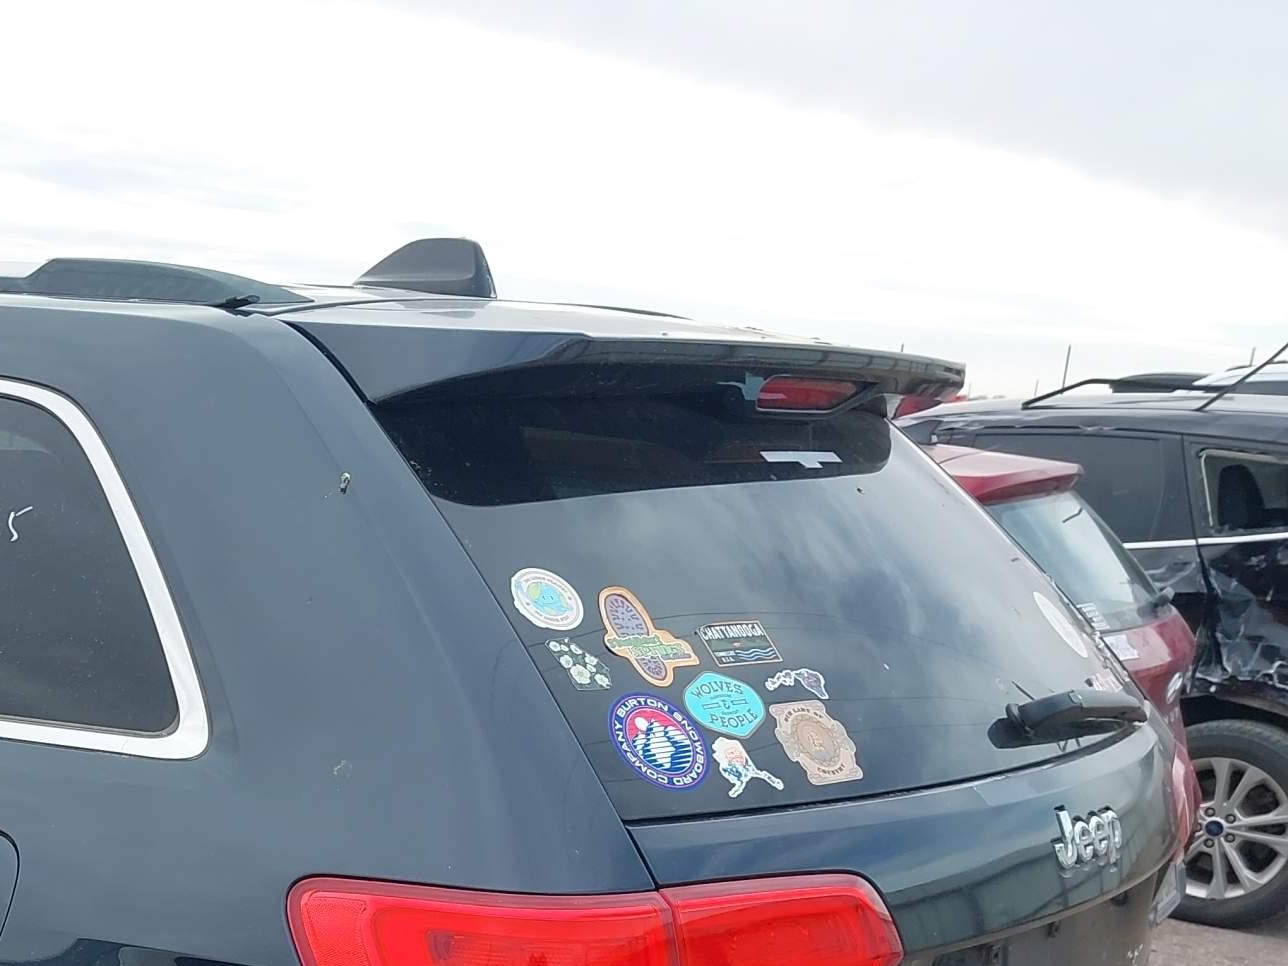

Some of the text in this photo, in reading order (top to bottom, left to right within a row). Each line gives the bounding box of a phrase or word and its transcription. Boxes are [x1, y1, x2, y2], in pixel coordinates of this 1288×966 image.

[700, 623, 765, 641] CHATTANOOGA
[690, 680, 744, 699] WOLVES
[616, 697, 669, 718] BURTON
[709, 708, 758, 729] PEOPLE
[614, 720, 668, 785] COMPANY
[672, 711, 705, 786] SNOWBOARD
[1052, 807, 1122, 868] Jeep
